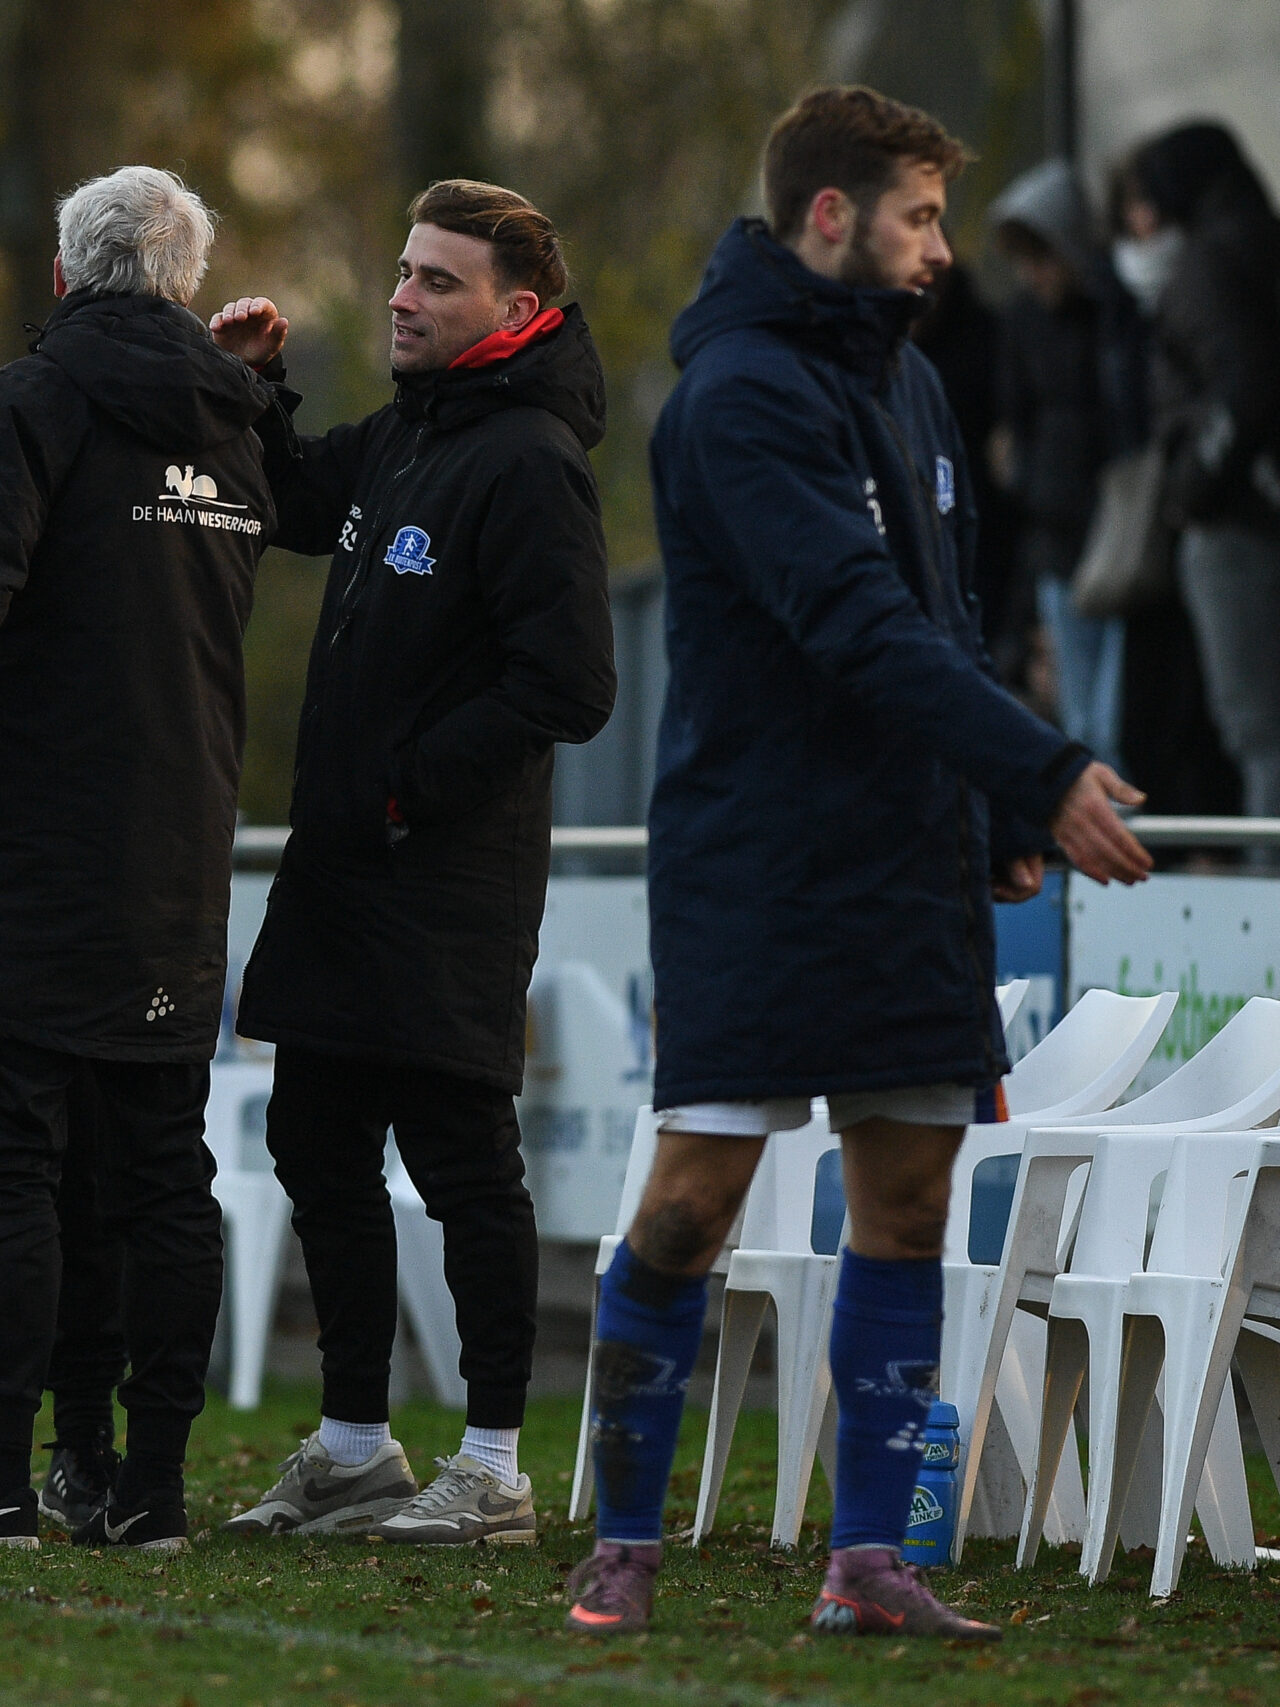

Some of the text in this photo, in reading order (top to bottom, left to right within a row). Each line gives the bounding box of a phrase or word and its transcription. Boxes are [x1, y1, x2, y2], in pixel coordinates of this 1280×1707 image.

[132, 506, 153, 521] DE
[157, 506, 196, 525] HAAN
[909, 1511, 934, 1525] RINK
